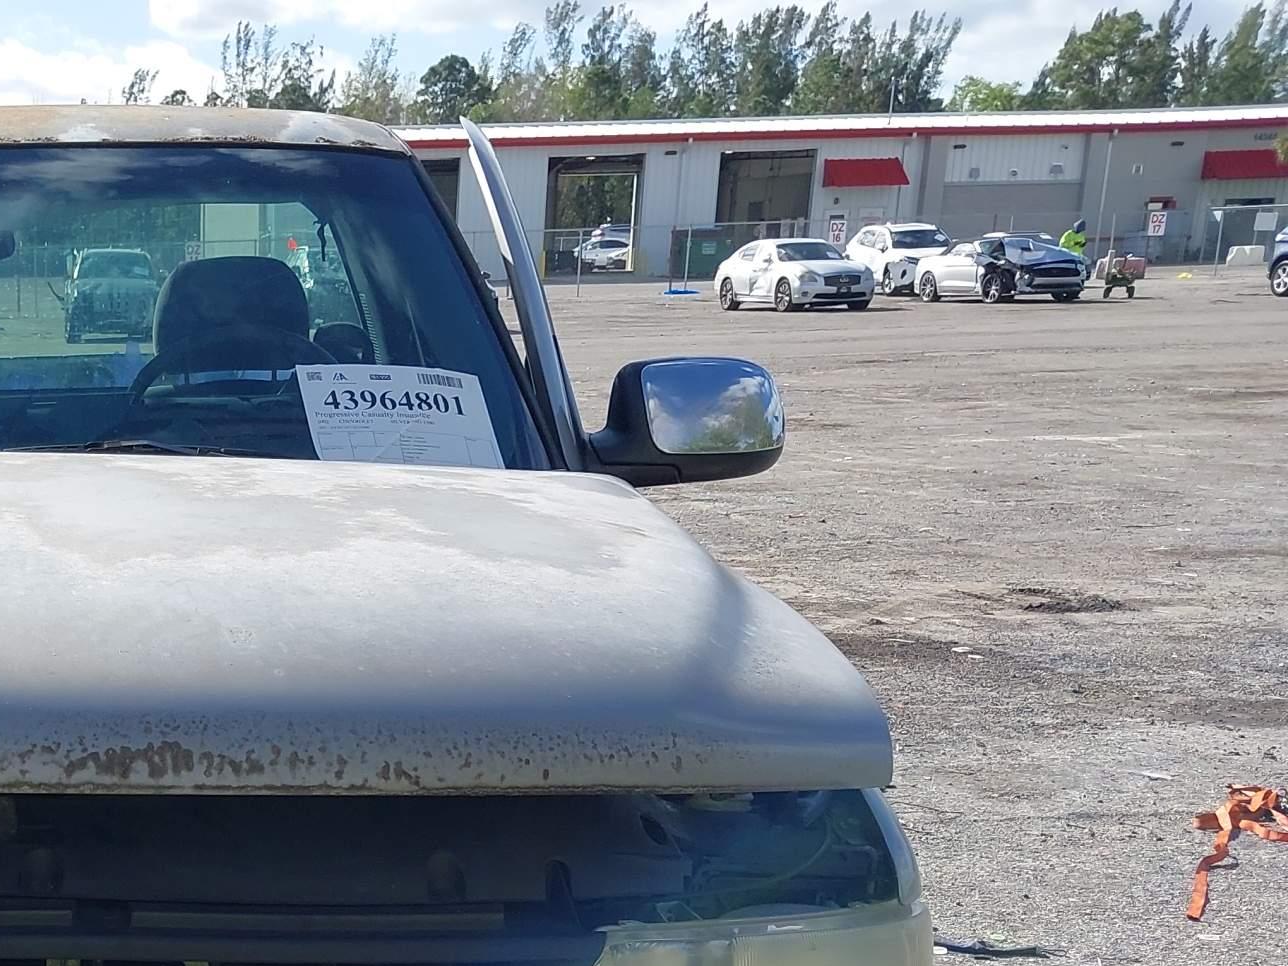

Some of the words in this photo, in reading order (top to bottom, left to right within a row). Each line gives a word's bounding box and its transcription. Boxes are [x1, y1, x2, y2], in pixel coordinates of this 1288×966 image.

[1151, 214, 1165, 224] DZ
[831, 222, 846, 233] DZ
[1152, 225, 1162, 234] 17
[832, 233, 841, 243] 16
[324, 389, 467, 417] 43964801
